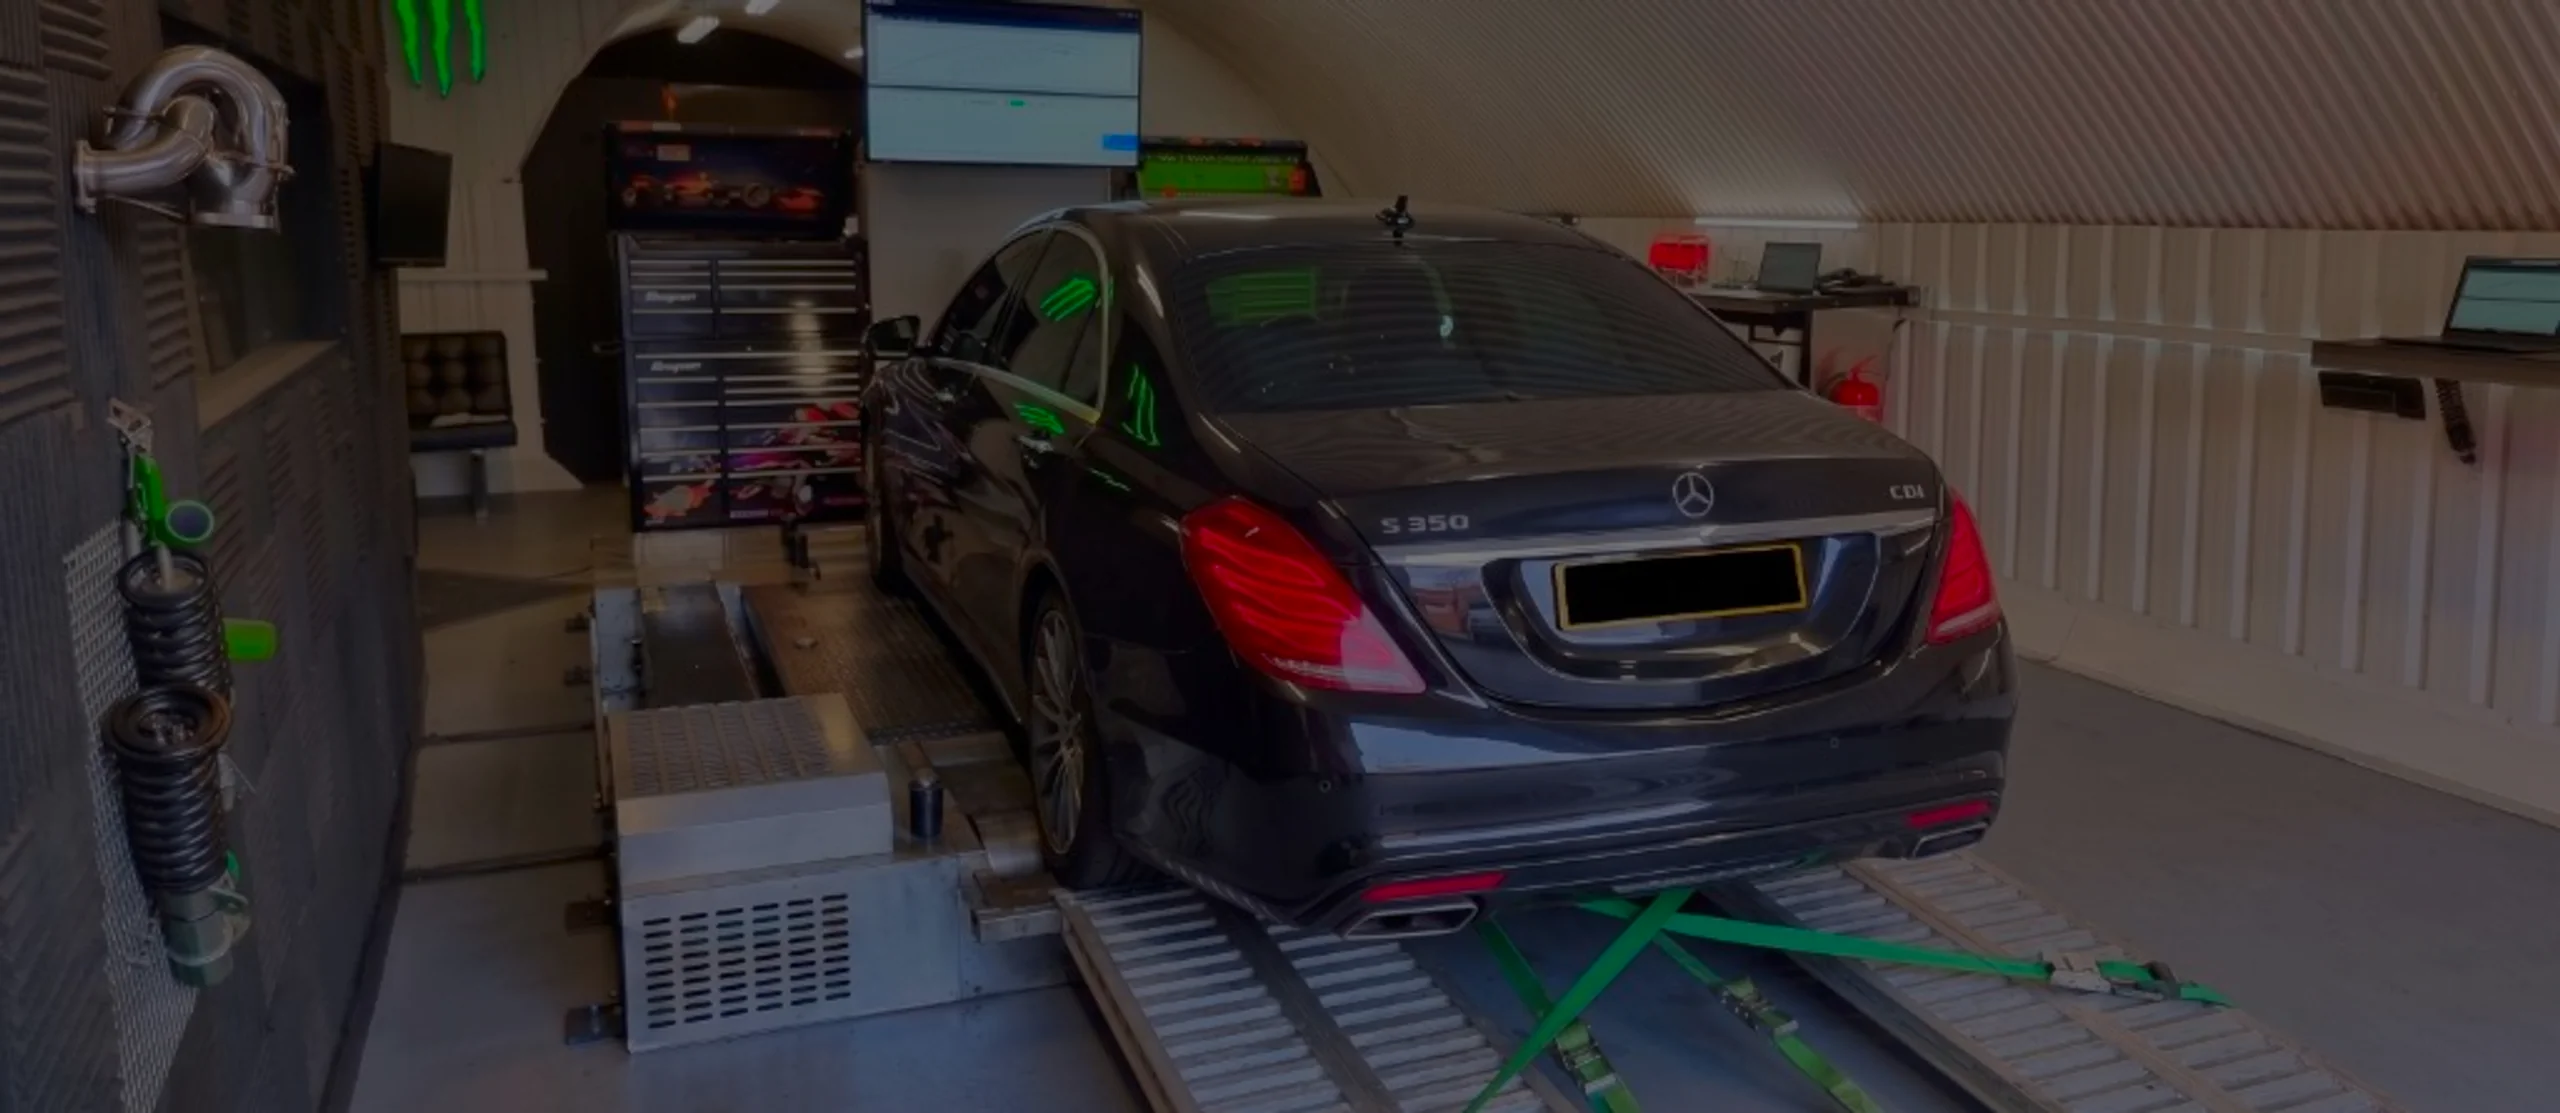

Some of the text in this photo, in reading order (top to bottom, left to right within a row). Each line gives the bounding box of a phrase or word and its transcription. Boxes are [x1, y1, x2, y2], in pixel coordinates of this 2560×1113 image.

[1889, 484, 1925, 500] CDI
[1380, 514, 1470, 535] S 350
